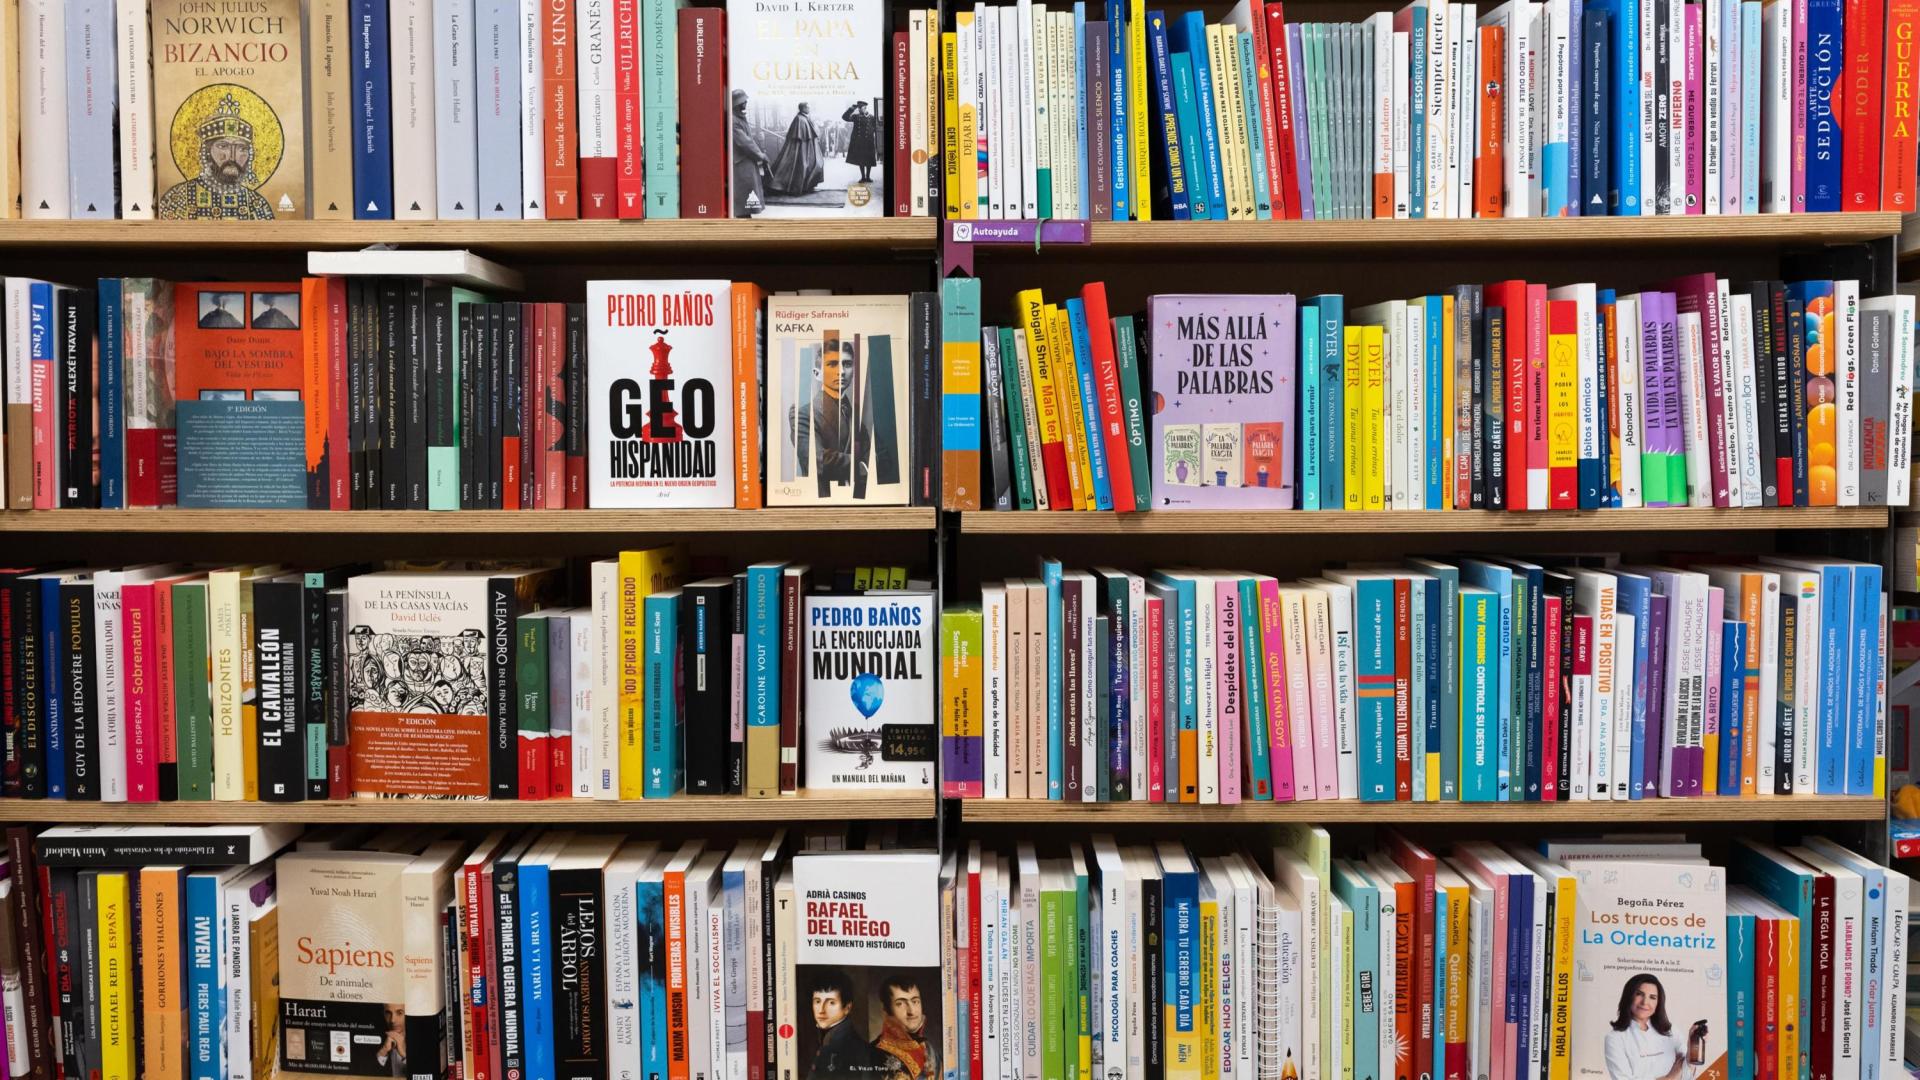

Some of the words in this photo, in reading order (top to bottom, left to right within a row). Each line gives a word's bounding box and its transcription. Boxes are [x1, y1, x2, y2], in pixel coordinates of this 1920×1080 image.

[179, 1, 215, 14] JOHN
[221, 0, 268, 13] JULIUS
[755, 1, 793, 12] DAVID
[796, 2, 802, 12] I.
[808, 1, 854, 12] KERTZER
[166, 16, 284, 34] NORWICH
[552, 0, 566, 46] KING
[590, 0, 602, 64] GRANÉS
[621, 0, 632, 71] ULLRICH
[1432, 13, 1444, 56] fuerte
[696, 18, 704, 58] BURLEIGH
[164, 42, 288, 63] BIZANCIO
[1276, 48, 1281, 57] EL
[195, 68, 207, 76] EL
[212, 68, 255, 76] APOGEO
[754, 61, 860, 81] GUERRA
[1894, 22, 1912, 138] GUERRA
[1114, 68, 1124, 114] problemas
[1279, 81, 1285, 90] DE
[1432, 59, 1445, 115] Siempre
[1817, 33, 1832, 160] SEDUCCIÓN
[555, 84, 564, 118] rebeldes
[624, 98, 632, 118] mayo
[1280, 92, 1289, 130] RENACER
[556, 120, 564, 132] de
[624, 120, 632, 130] de
[1164, 113, 1178, 145] APRENDE
[556, 134, 564, 167] Escuela
[624, 132, 632, 150] días
[624, 152, 632, 176] Ocho
[1114, 132, 1125, 190] Gestionando
[1168, 146, 1180, 166] COMO
[1171, 168, 1182, 178] UN
[1172, 179, 1184, 193] PRO
[973, 227, 1018, 237] Autoayuda
[608, 294, 655, 327] PEDRO
[663, 291, 713, 326] BAÑOS
[775, 310, 809, 320] Rüdiger
[811, 310, 849, 319] Safranski
[1030, 302, 1044, 341] Abigail
[68, 306, 77, 352] NAVALNI
[775, 323, 814, 333] KAFKA
[1177, 313, 1219, 340] MÁS
[1225, 313, 1267, 340] ALLÁ
[1326, 320, 1337, 358] DYER
[988, 343, 996, 369] JORGE
[1192, 344, 1214, 367] DE
[1219, 343, 1253, 367] LAS
[1644, 321, 1658, 373] PALABRAS
[1036, 345, 1048, 380] Shrier
[1347, 344, 1360, 388] DYER
[1368, 345, 1380, 388] DYER
[990, 371, 1000, 397] BUCAY
[1177, 370, 1273, 394] PALABRAS
[1646, 376, 1659, 389] EN
[609, 378, 716, 439] GEO
[1646, 392, 1660, 416] VIDA
[1128, 399, 1142, 446] ÓPTIMO
[1308, 417, 1317, 439] para
[1491, 421, 1501, 449] CAÑETE
[1647, 417, 1660, 429] LA
[610, 440, 716, 478] HISPANIDAD
[1308, 465, 1315, 476] La
[1493, 451, 1501, 477] CURRO
[364, 600, 377, 610] DE
[380, 600, 398, 610] LAS
[400, 601, 430, 610] CASAS
[434, 600, 469, 611] VACÍAS
[380, 590, 392, 599] LA
[395, 589, 451, 599] PENÍNSULA
[1600, 588, 1614, 620] VIDAS
[71, 598, 81, 650] POPULUS
[390, 612, 416, 622] David
[419, 613, 442, 622] Uclés
[812, 606, 863, 626] PEDRO
[869, 602, 922, 626] BAÑOS
[1224, 596, 1234, 627] dolor
[495, 591, 508, 665] ALEJANDRO
[812, 630, 828, 649] LA
[832, 630, 922, 649] ENCRUCIJADA
[1224, 631, 1235, 649] del
[1600, 624, 1613, 638] EN
[130, 608, 143, 694] Sobrenatural
[758, 644, 766, 672] VOUT
[258, 629, 281, 721] CAMALEÓN
[813, 652, 922, 680] MUNDIAL
[1598, 642, 1612, 693] POSITIVO
[70, 654, 83, 713] BÉDOYÈRE
[220, 648, 232, 736] HORIZONTES
[1224, 652, 1237, 714] Despídete
[1476, 666, 1485, 712] CONTROLE
[75, 716, 83, 727] LA
[1476, 714, 1485, 727] SU
[75, 732, 84, 749] DE
[263, 729, 281, 746] EL
[1476, 728, 1484, 766] DESTINO
[76, 752, 85, 777] GUY
[832, 775, 840, 783] UN
[842, 774, 866, 783] MANUAL
[869, 774, 879, 783] DEL
[881, 772, 906, 783] MAÑANA
[310, 887, 330, 898] Yuval
[331, 888, 352, 898] Noah
[353, 888, 377, 898] Harari
[806, 889, 830, 899] ADRIÀ
[832, 890, 866, 900] CASINOS
[1617, 897, 1654, 910] Begoña
[1656, 898, 1685, 909] Pérez
[1820, 896, 1829, 908] LA
[669, 894, 680, 939] INVISIBLES
[806, 902, 867, 919] RAFAEL
[1177, 902, 1189, 935] MEJORA
[1591, 910, 1621, 925] Los
[1624, 913, 1683, 927] trucos
[1688, 914, 1706, 928] de
[106, 903, 117, 949] ESPAÑA
[808, 920, 836, 935] DEL
[842, 920, 890, 937] RIEGO
[1820, 910, 1829, 940] REGLA
[195, 916, 211, 969] ¡VIVEN!
[501, 916, 511, 963] PRIMERA
[1179, 937, 1189, 948] TU
[1583, 929, 1603, 944] La
[1611, 929, 1716, 950] Ordenatriz
[297, 936, 394, 974] Sapiens
[669, 941, 682, 989] FRONTERAS
[1820, 943, 1828, 970] MOLA
[110, 957, 118, 988] REID
[1179, 951, 1189, 986] CEREBRO
[1361, 971, 1372, 988] GIRL
[320, 976, 333, 988] De
[336, 977, 373, 989] animales
[502, 965, 516, 1007] GUERRA
[1558, 973, 1568, 1002] ELLOS
[285, 1002, 327, 1018] Harari
[1179, 988, 1190, 1011] CADA
[1362, 990, 1373, 1012] REBEL
[110, 992, 119, 1046] MICHAEL
[1180, 1014, 1190, 1027] DÍA
[1557, 1004, 1567, 1023] CON
[505, 1010, 518, 1057] MUNDIAL
[1556, 1026, 1566, 1057] HABLA
